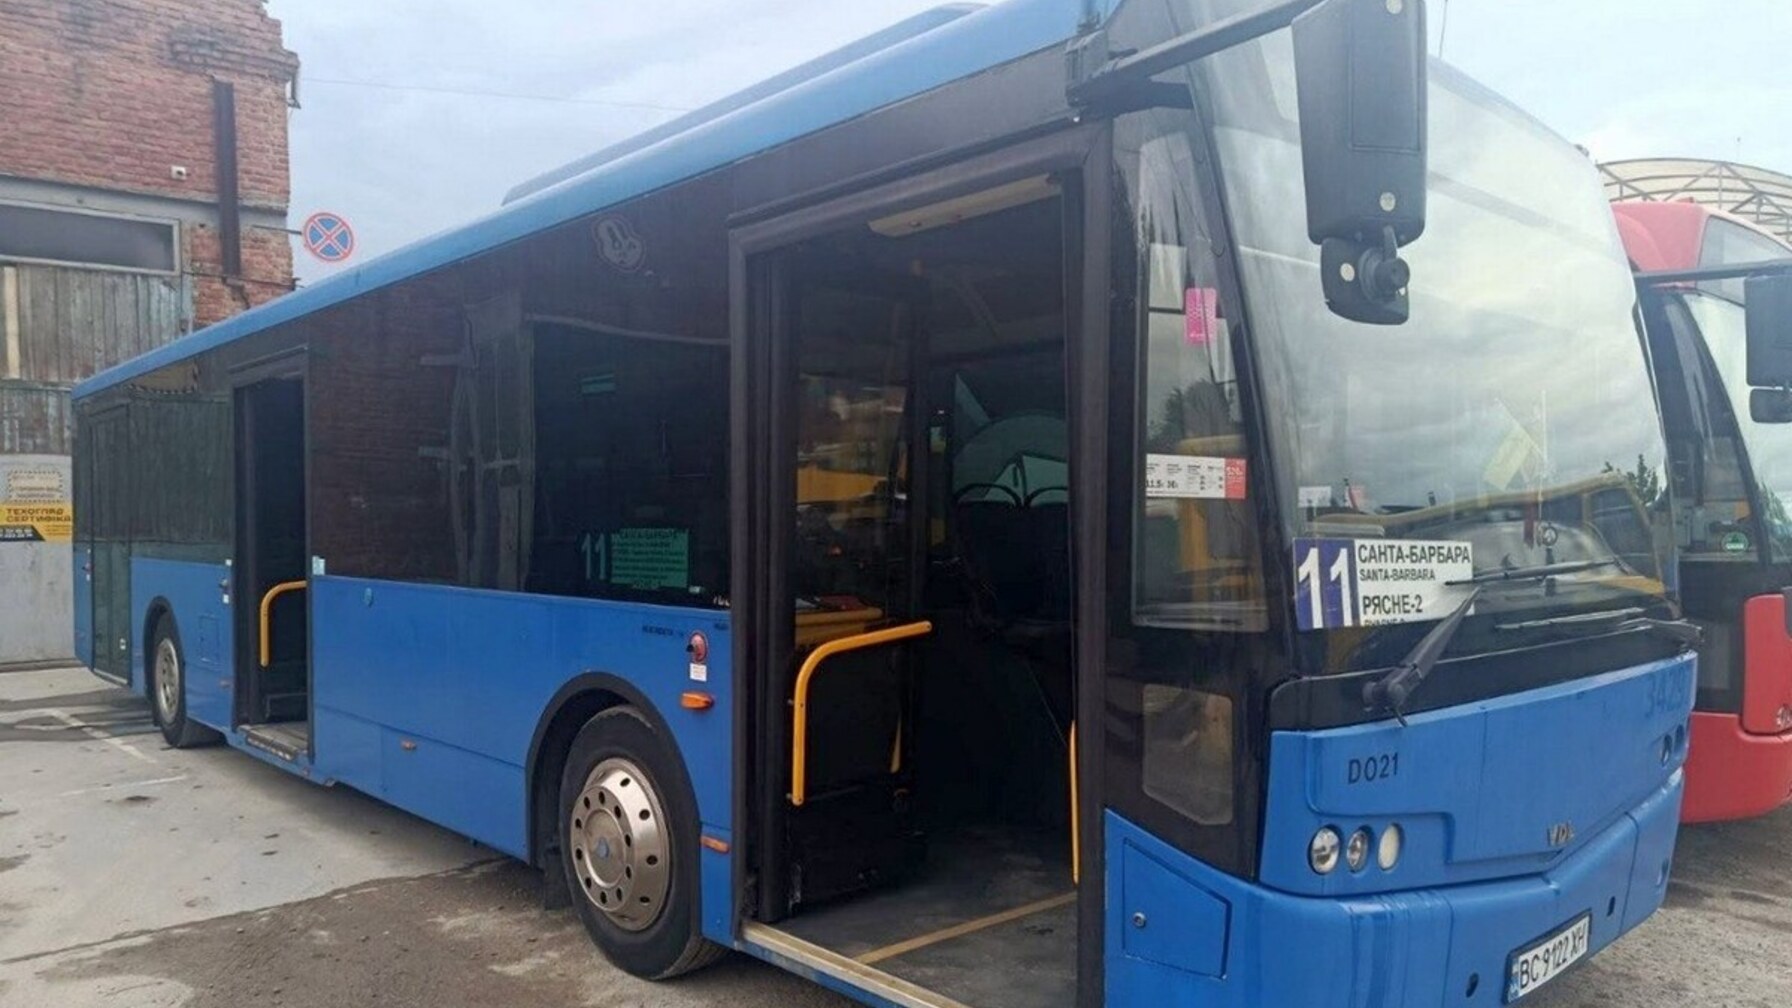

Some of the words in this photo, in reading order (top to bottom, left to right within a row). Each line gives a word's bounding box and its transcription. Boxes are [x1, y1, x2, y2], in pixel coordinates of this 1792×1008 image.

[581, 532, 606, 580] 11
[1357, 544, 1471, 564] САНТА-БАРБАРА
[1298, 547, 1354, 629] 11
[1359, 568, 1436, 582] SANTA-BARBARA
[1362, 594, 1424, 615] РЯСНЕ-2
[1543, 936, 1569, 977] 9122
